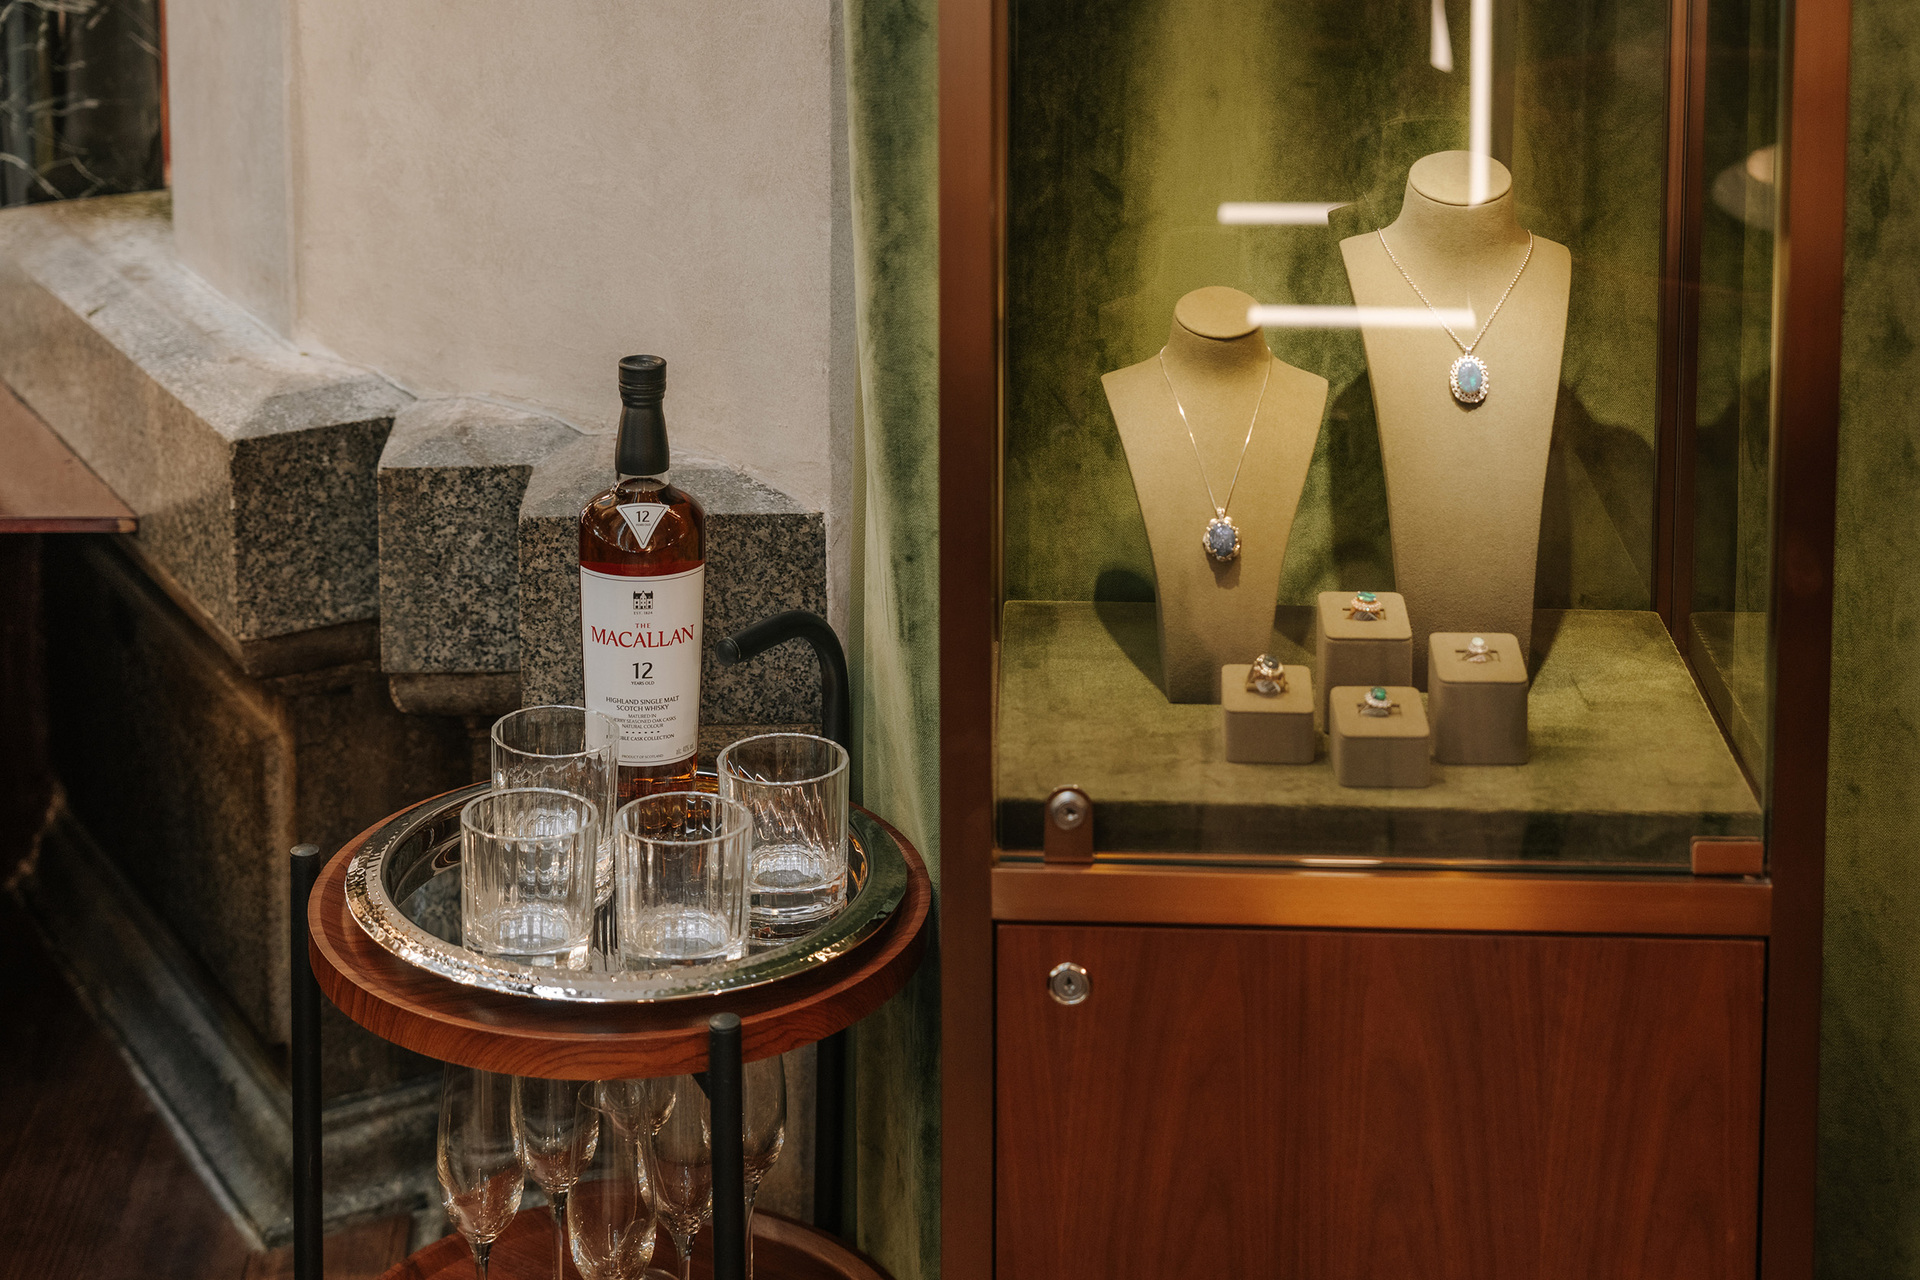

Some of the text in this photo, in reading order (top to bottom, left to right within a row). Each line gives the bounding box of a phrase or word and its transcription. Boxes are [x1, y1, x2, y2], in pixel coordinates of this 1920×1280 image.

[636, 510, 650, 522] 12
[591, 624, 694, 648] MACALLAN
[632, 662, 653, 679] 12
[606, 695, 680, 705] HIGHLAND SINGLE MALT
